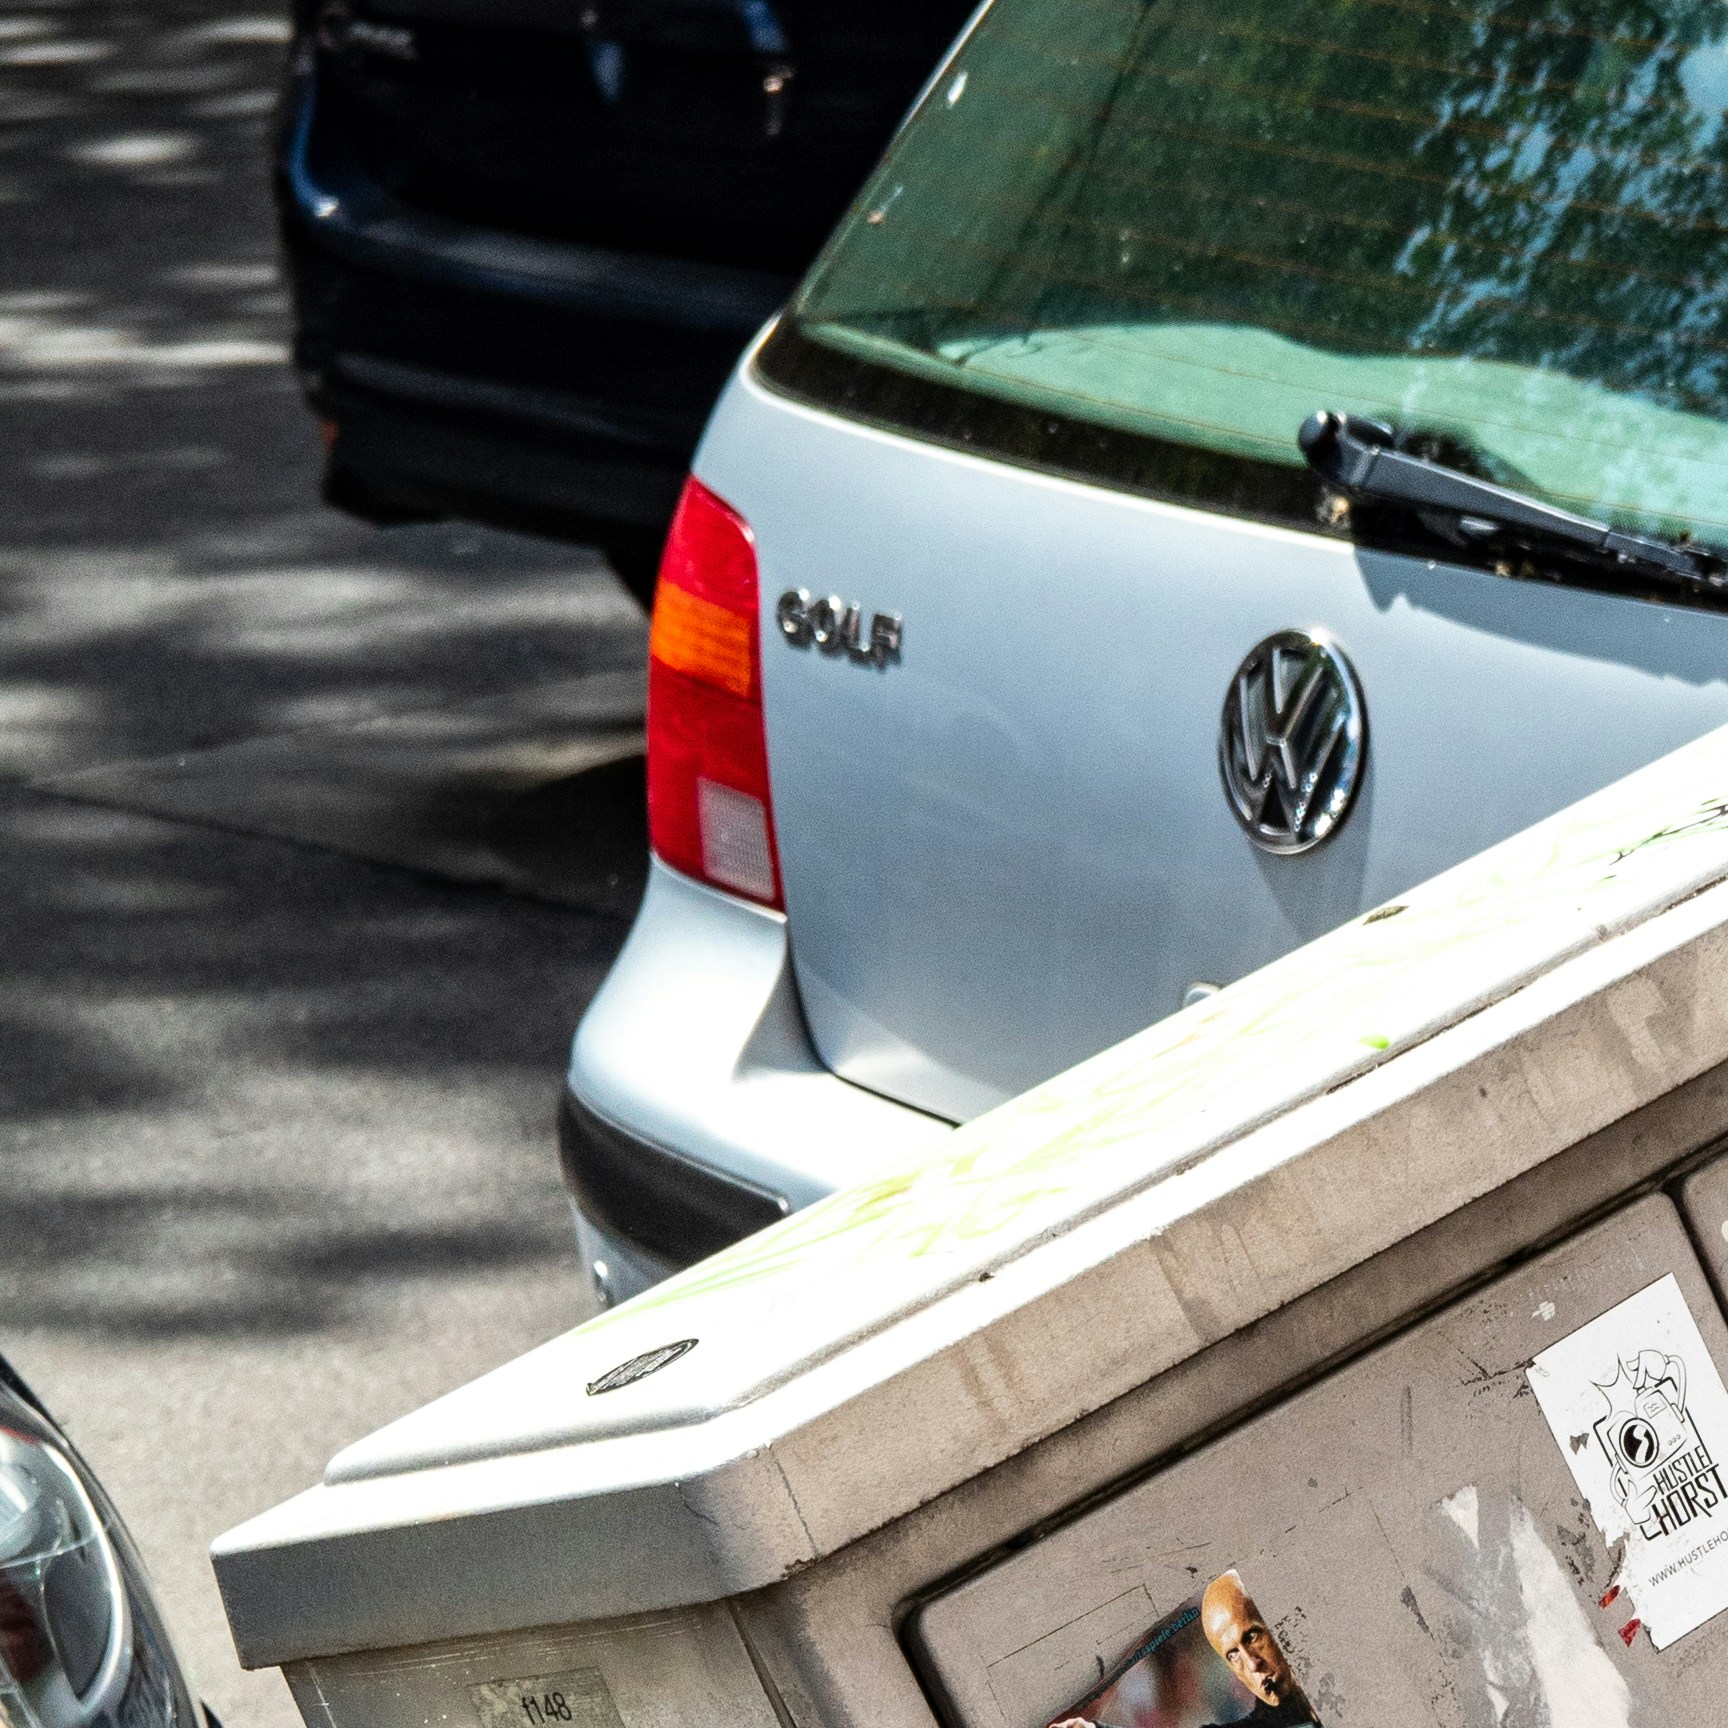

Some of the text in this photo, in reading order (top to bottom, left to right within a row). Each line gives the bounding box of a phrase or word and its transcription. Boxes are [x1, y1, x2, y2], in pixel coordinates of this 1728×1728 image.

[777, 588, 903, 673] GOLF
[1224, 634, 1362, 849] VW
[1651, 1463, 1728, 1537] HORST
[1652, 1445, 1709, 1496] HUSTLE
[521, 1691, 573, 1726] f148
